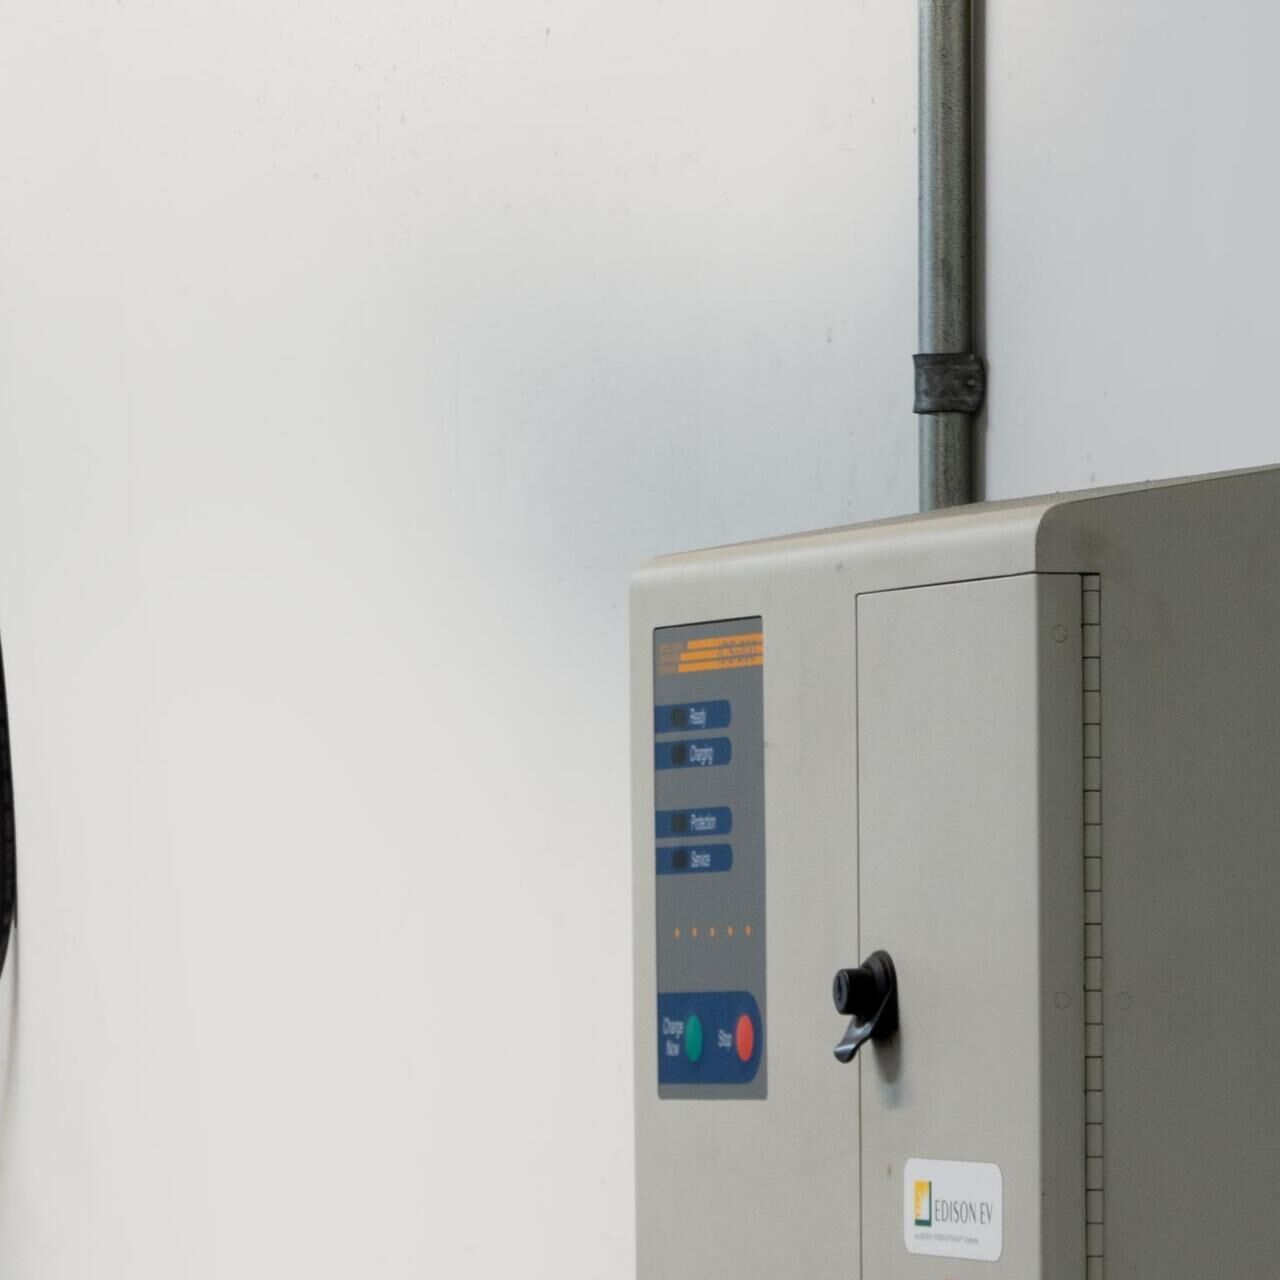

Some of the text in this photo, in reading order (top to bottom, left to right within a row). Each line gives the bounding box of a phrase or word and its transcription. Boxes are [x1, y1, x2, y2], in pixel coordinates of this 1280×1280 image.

[689, 744, 714, 766] Charging
[690, 850, 711, 868] Service
[934, 1199, 993, 1225] EDISON EV
